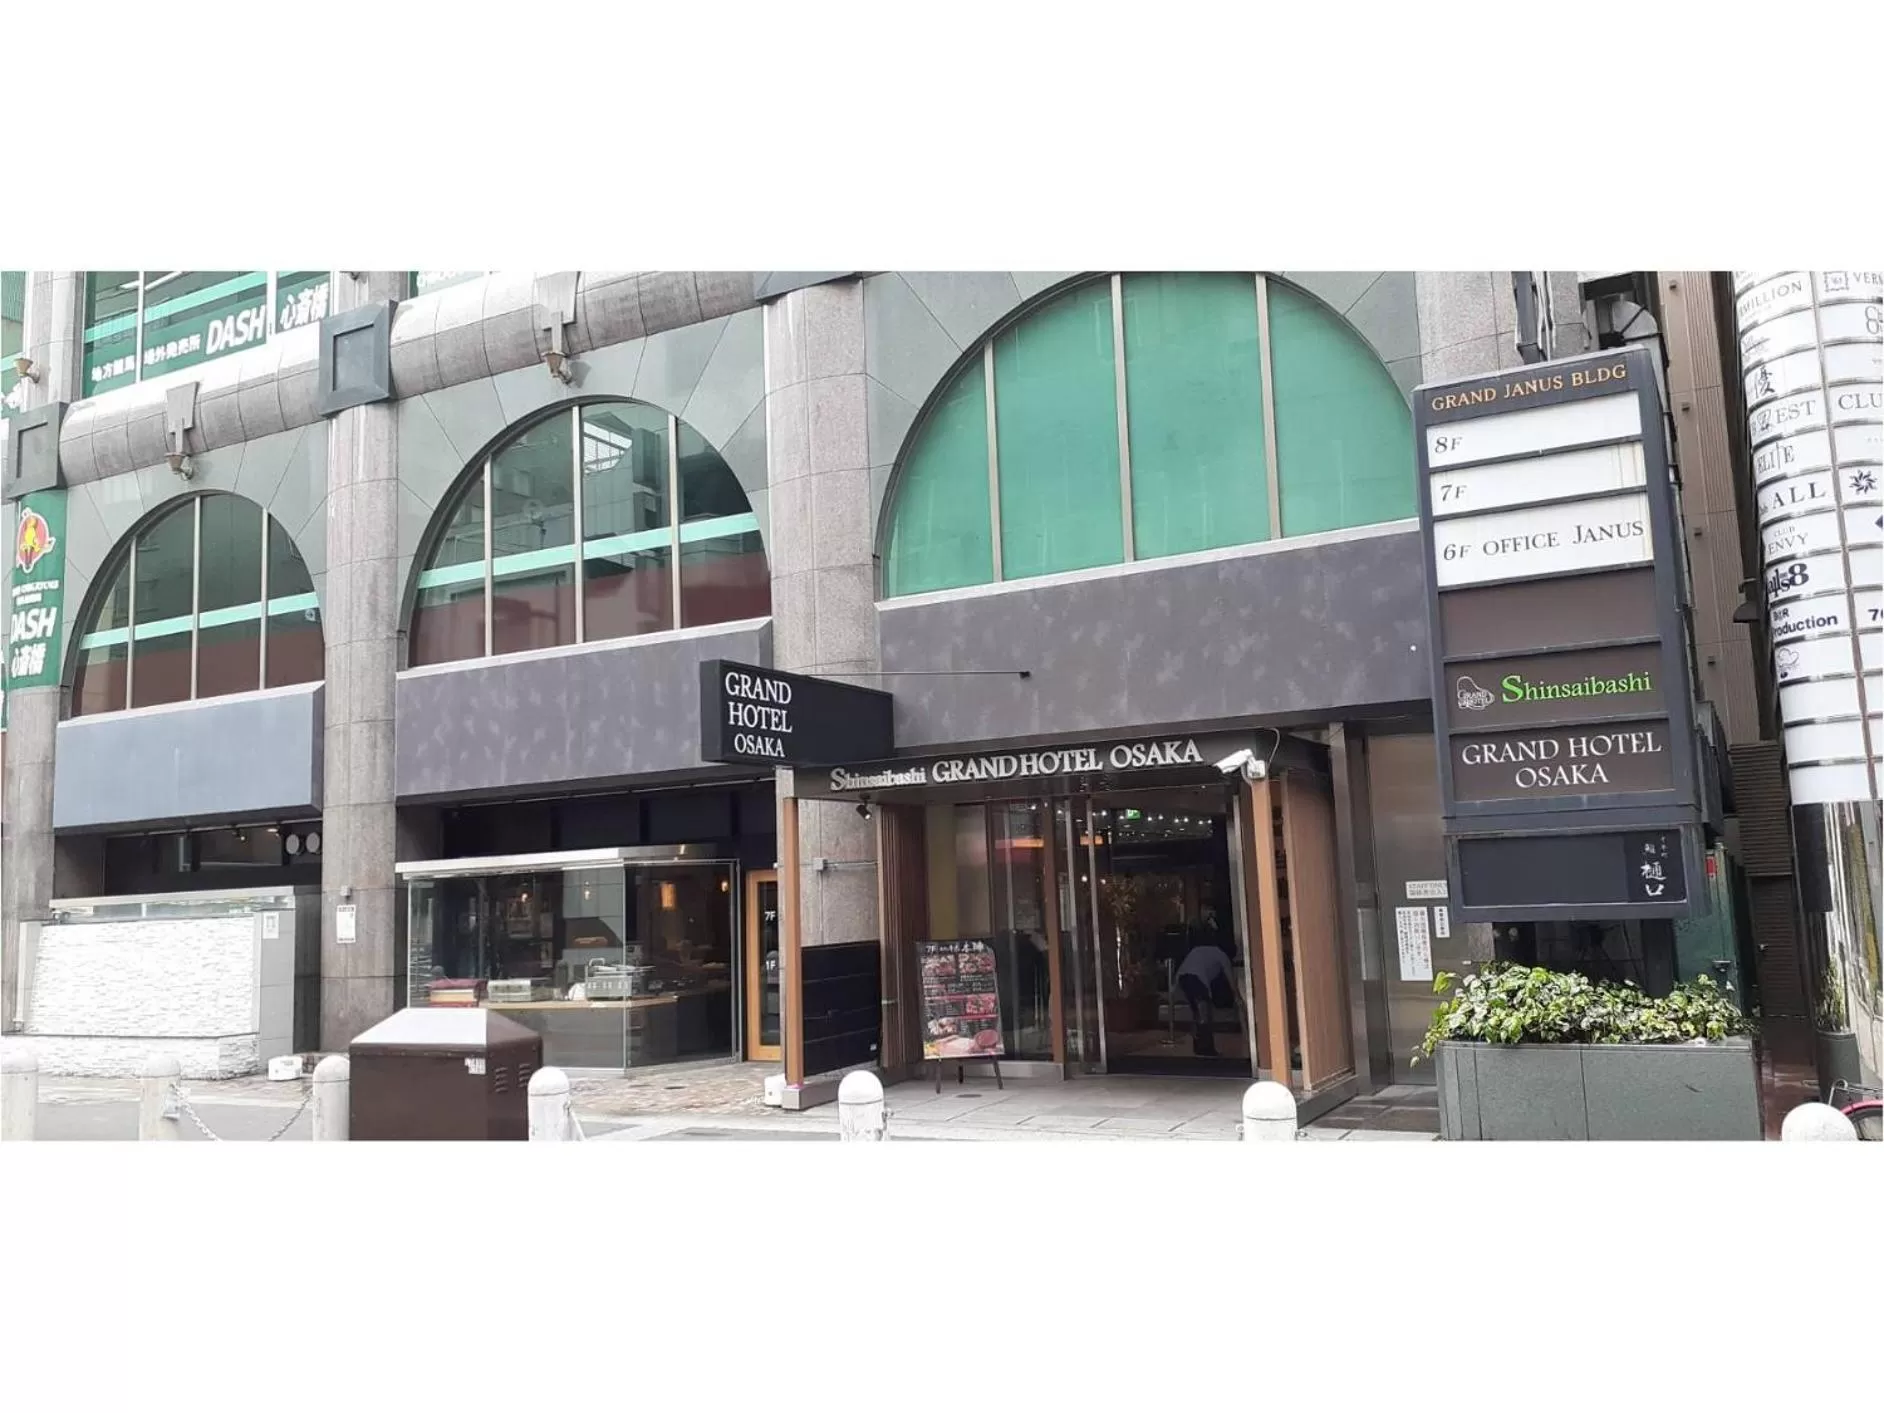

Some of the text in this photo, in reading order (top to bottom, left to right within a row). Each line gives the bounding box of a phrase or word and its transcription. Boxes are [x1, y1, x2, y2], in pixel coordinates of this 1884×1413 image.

[205, 304, 266, 355] DASH
[1431, 364, 1627, 411] GRAND JANUS BLDG
[1434, 436, 1463, 453] 8F
[1440, 483, 1468, 501] 7F
[1443, 520, 1644, 561] 6F OFFICE JANUS
[725, 671, 793, 704] GRAND
[1502, 672, 1651, 702] Shinsaibashi
[727, 701, 793, 733] HOTEL
[733, 733, 786, 758] OSAKA
[1462, 732, 1662, 765] GRAND HOTEL
[830, 739, 1203, 791] Shinsaibashi GRAND HOTEL OSAKA
[1515, 763, 1609, 789] OSAKA
[764, 911, 776, 921] 7F
[765, 960, 776, 970] 1F
